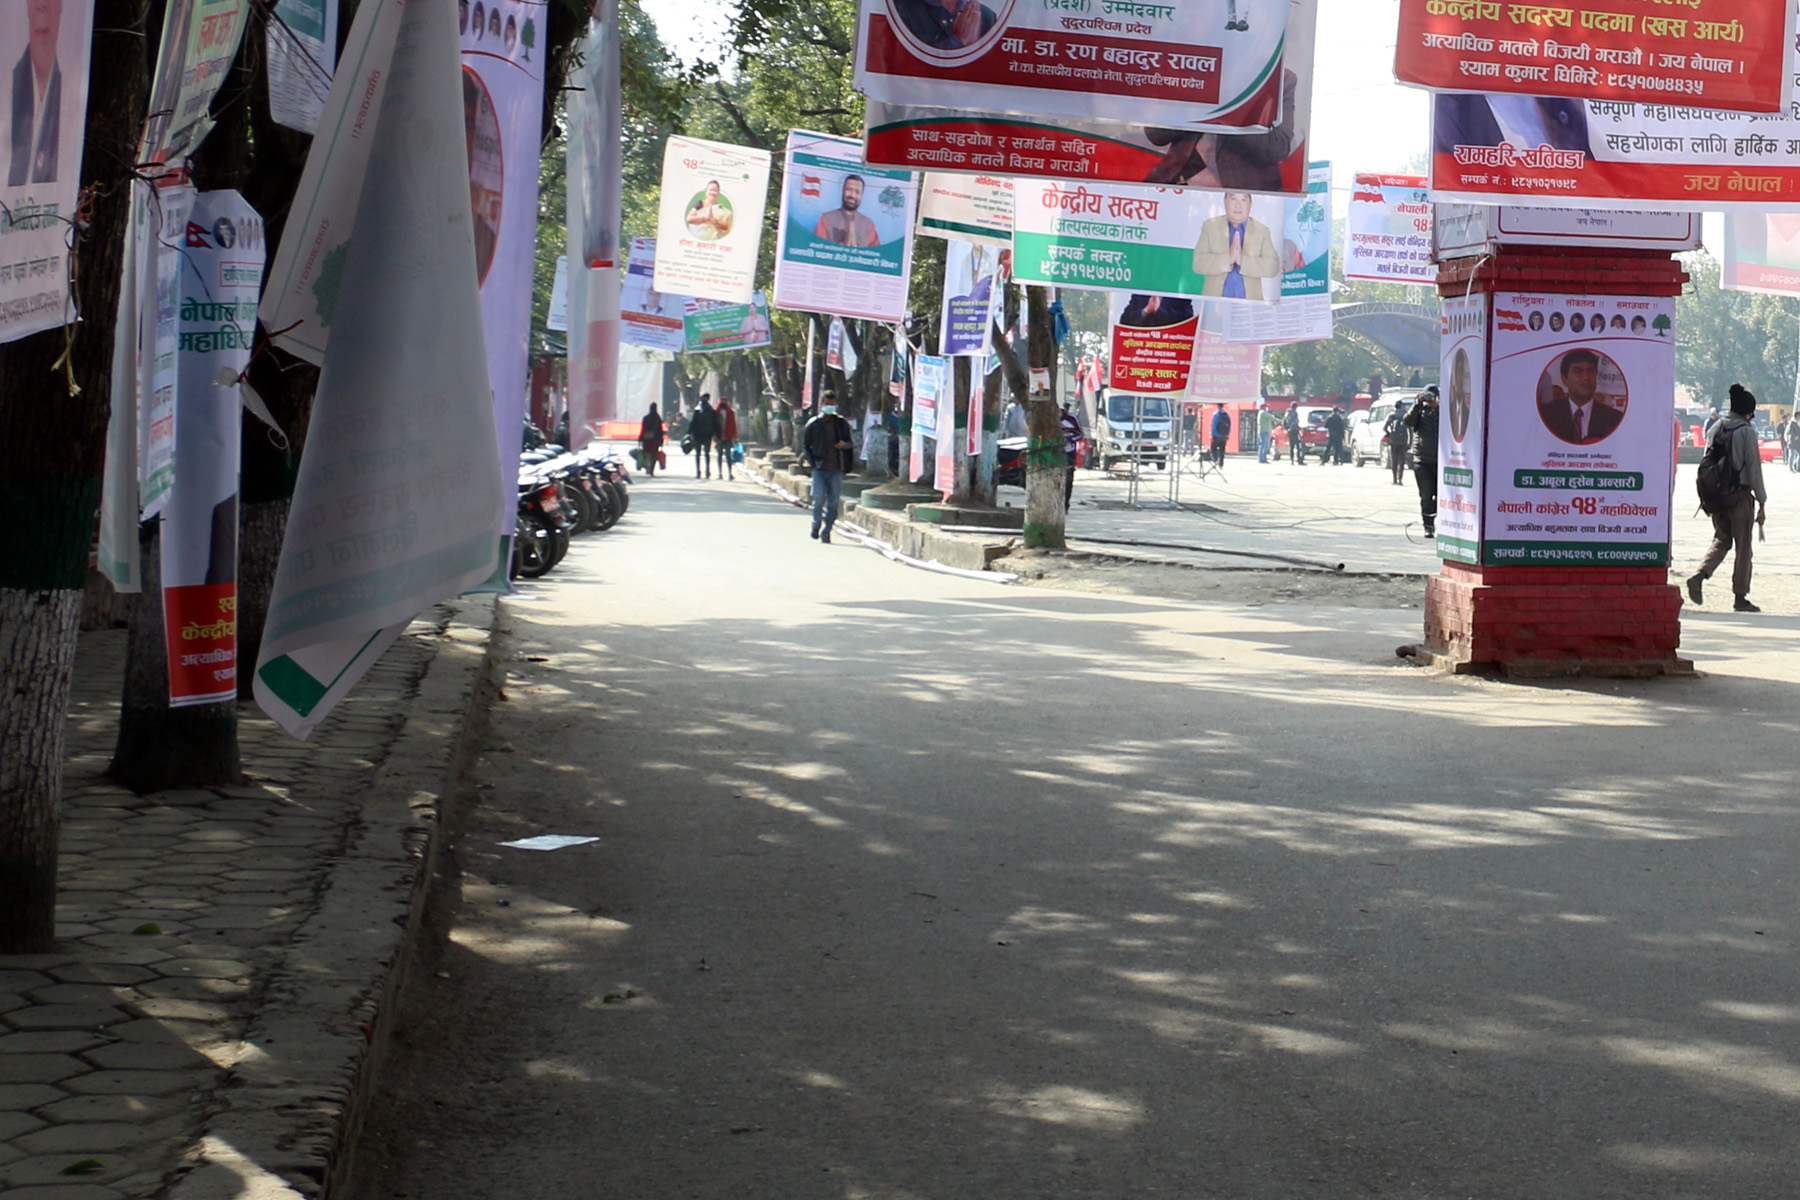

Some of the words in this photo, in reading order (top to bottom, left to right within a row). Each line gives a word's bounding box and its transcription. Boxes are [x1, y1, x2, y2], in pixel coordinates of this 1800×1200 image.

[1507, 4, 1571, 28] सदस्य
[1580, 11, 1634, 32] पदमा
[1685, 173, 1720, 192] जय
[1728, 171, 1781, 192] नेपाल
[1107, 196, 1159, 221] सदस्य
[1571, 497, 1597, 514] १४
